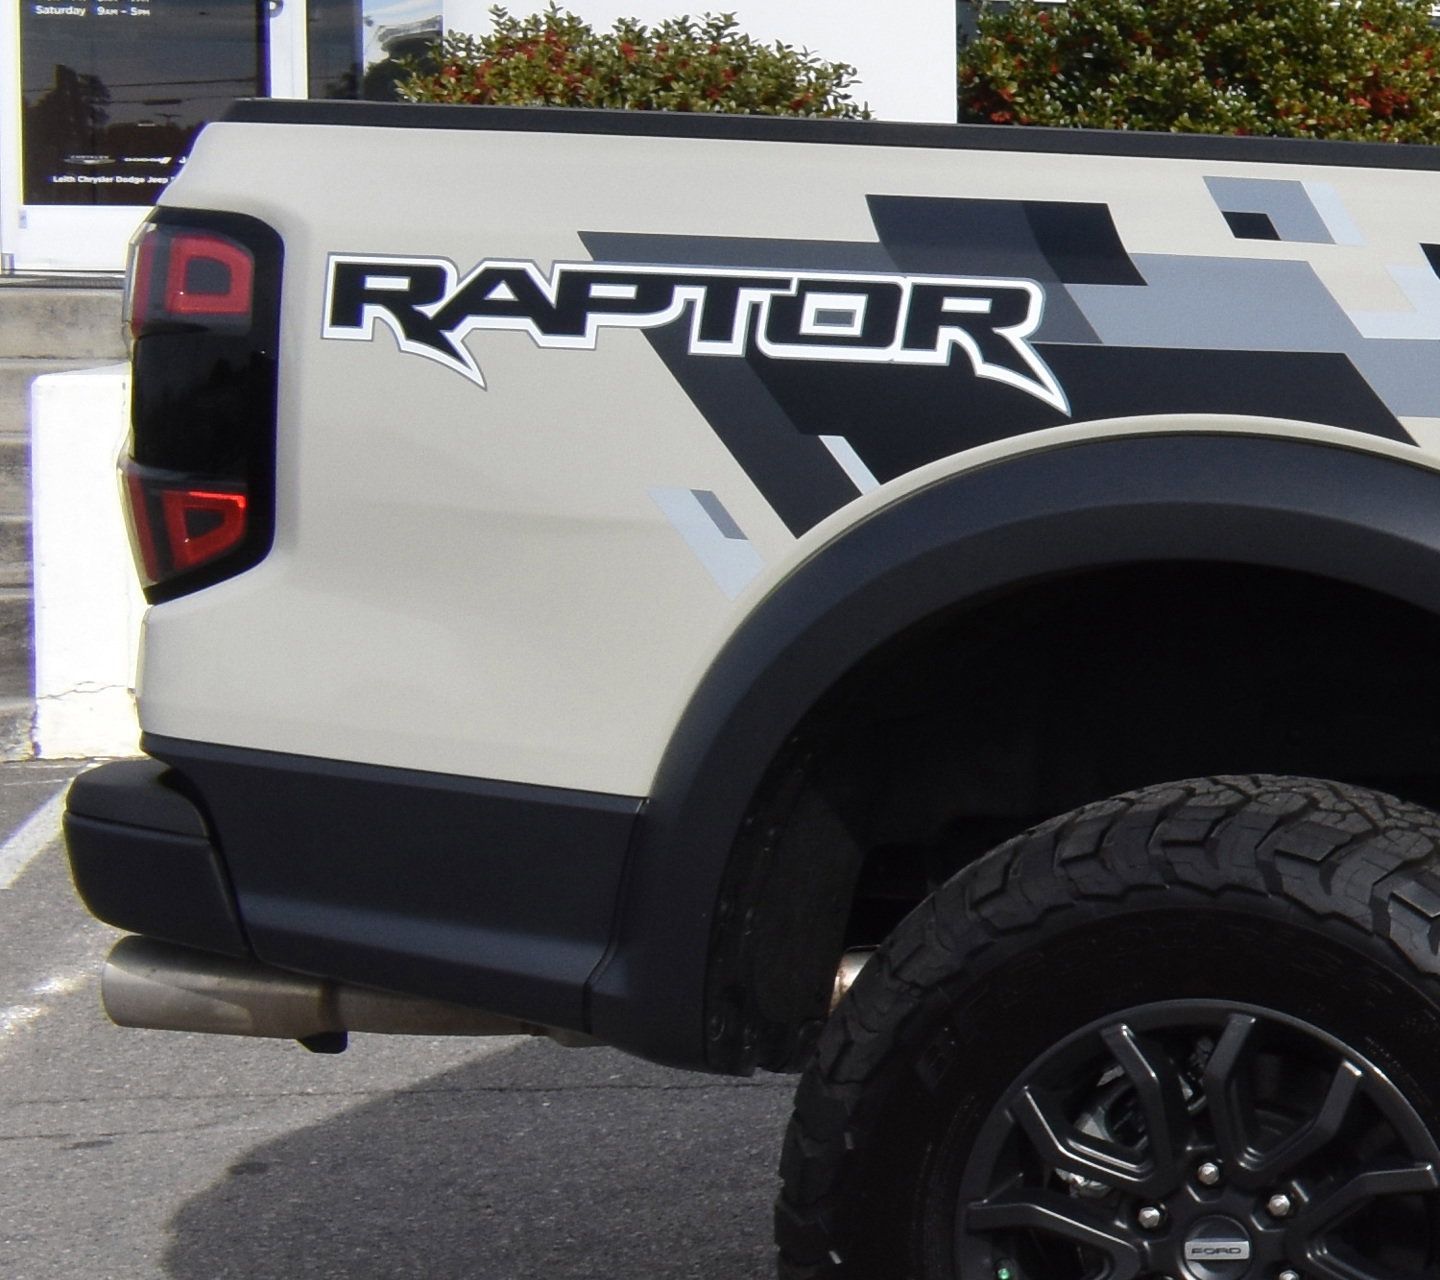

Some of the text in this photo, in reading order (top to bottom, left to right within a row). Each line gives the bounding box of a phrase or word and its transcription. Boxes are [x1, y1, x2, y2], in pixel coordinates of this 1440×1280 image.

[34, 5, 86, 16] Saturday
[52, 175, 169, 185] Leith Chrysler Dodge Jeep
[320, 252, 1071, 418] RAPTOR
[1191, 1247, 1242, 1256] FORD
